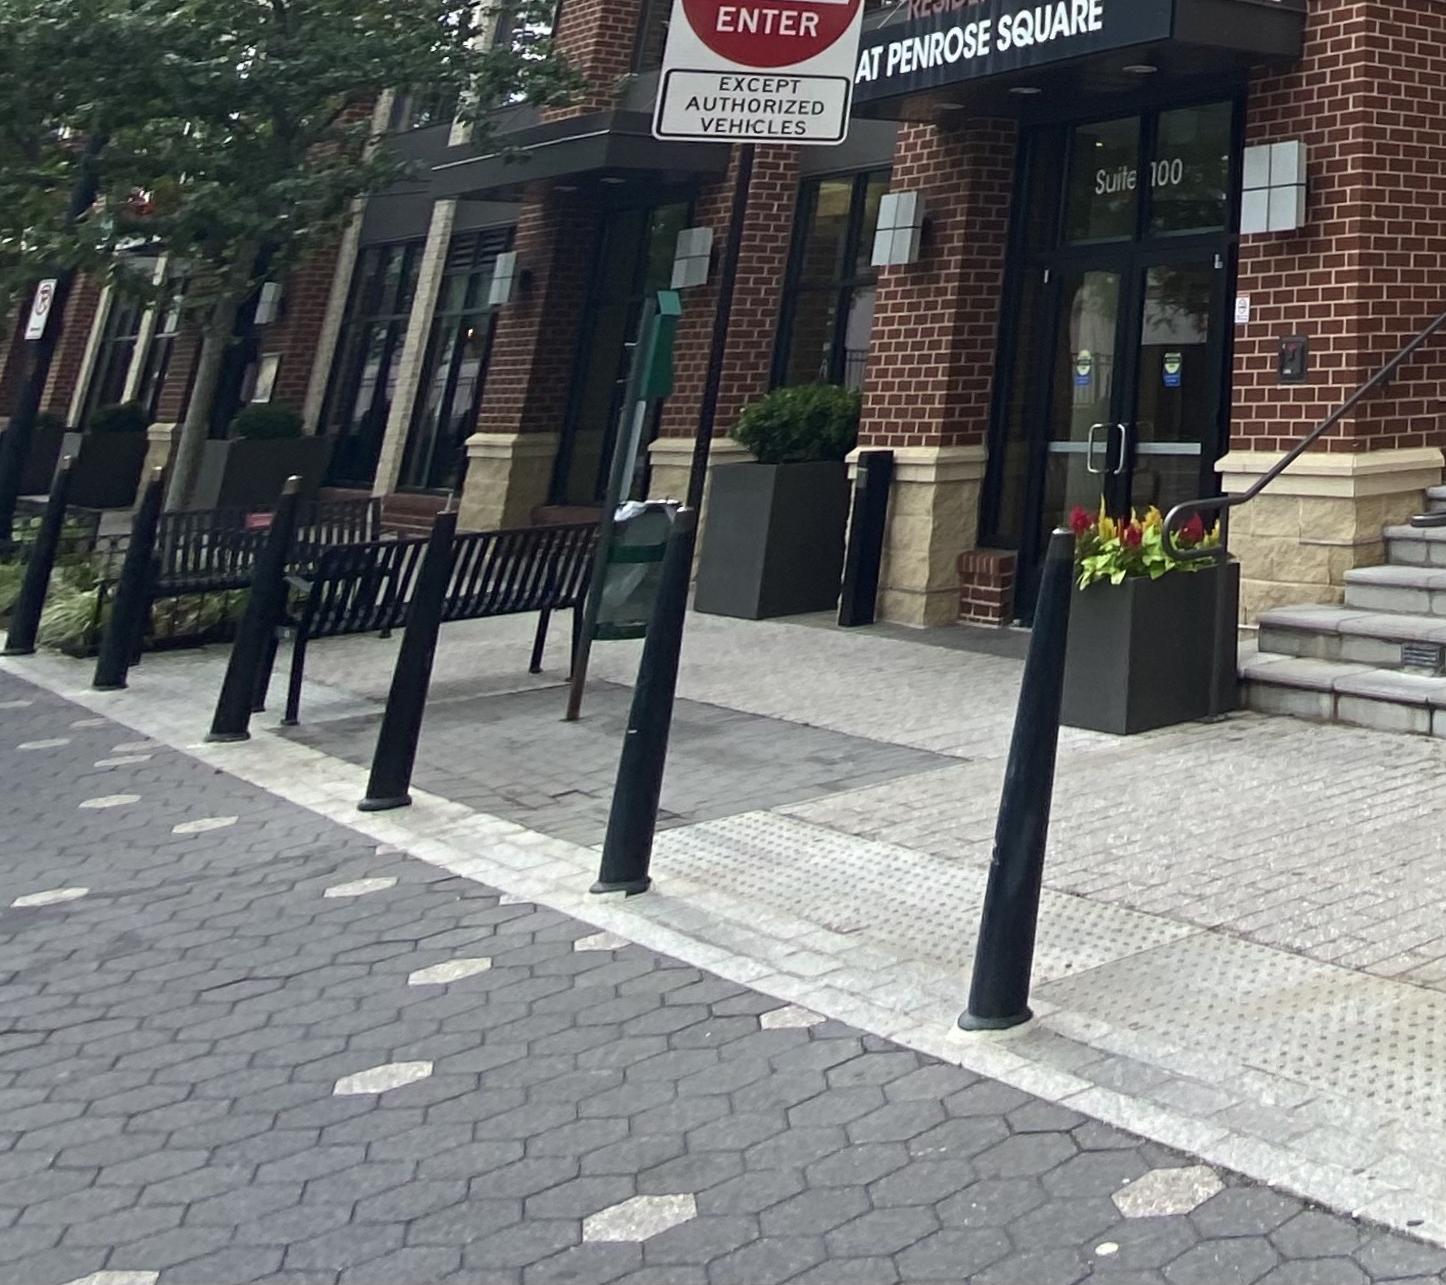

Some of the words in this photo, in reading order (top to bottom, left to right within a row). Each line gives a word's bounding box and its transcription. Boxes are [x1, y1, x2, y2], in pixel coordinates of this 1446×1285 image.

[716, 6, 819, 37] ENTER
[855, 45, 884, 83] AT
[886, 19, 991, 77] PENROSE
[719, 76, 802, 94] EXCEPT
[684, 96, 825, 116] AUTHORIZED
[700, 117, 807, 136] VEHICLES
[1095, 165, 1137, 195] Suite
[1150, 158, 1183, 187] 100
